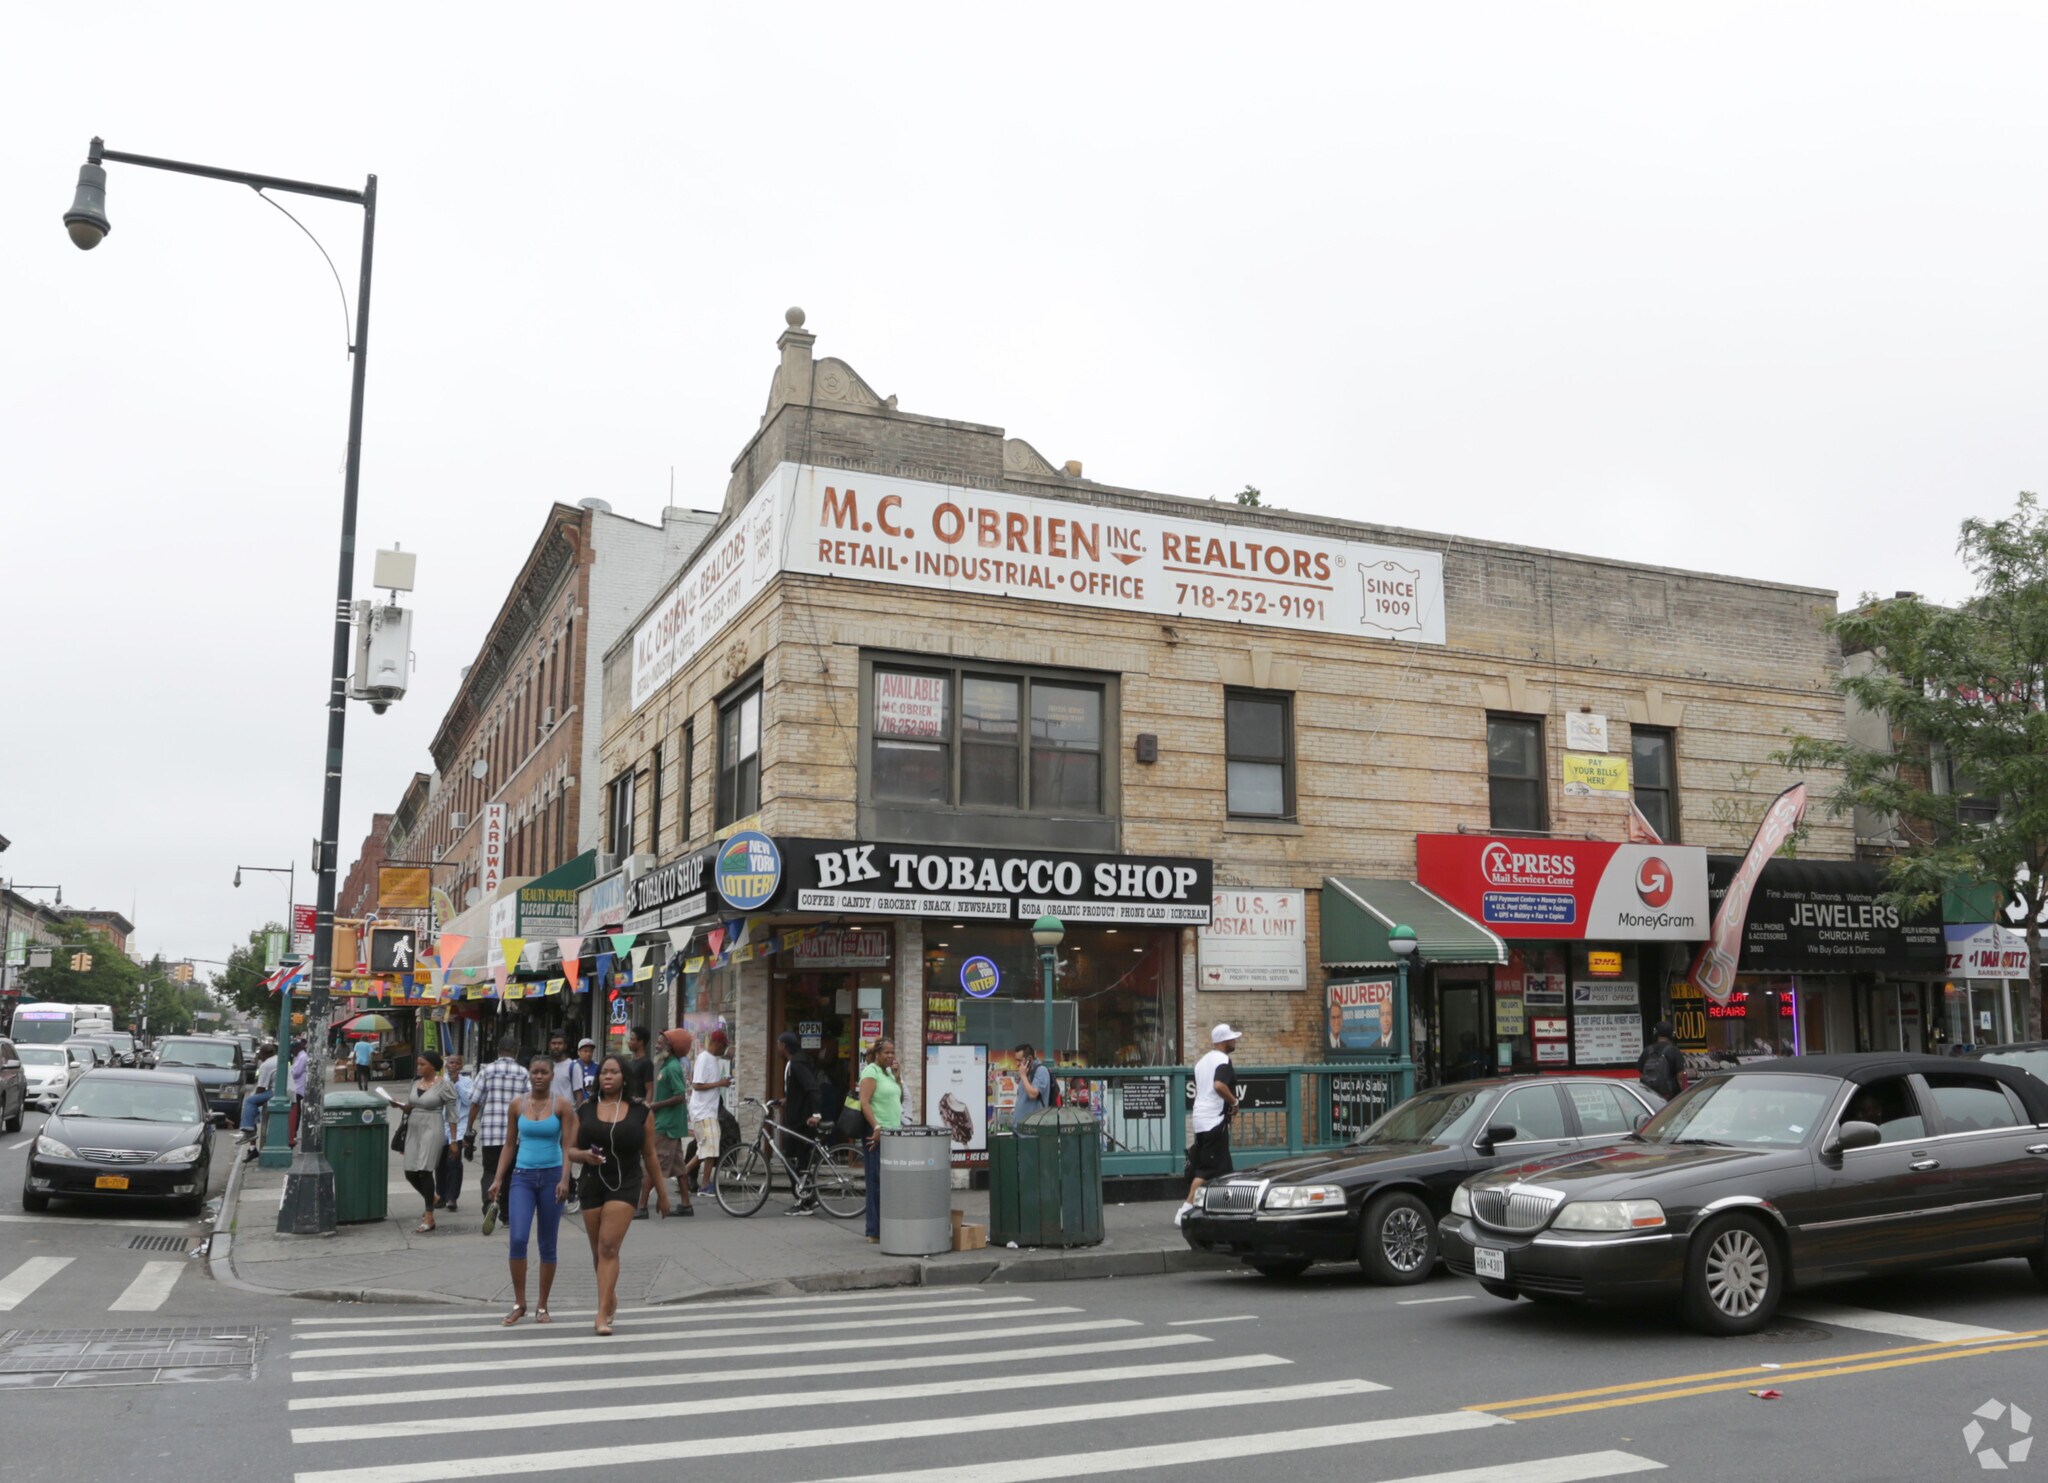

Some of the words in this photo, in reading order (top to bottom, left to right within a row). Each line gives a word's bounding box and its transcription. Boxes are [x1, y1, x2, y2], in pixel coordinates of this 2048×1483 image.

[820, 487, 914, 539] M.C.
[932, 502, 1100, 562] O'BRIEN
[1107, 526, 1146, 552] INC.
[819, 539, 899, 571] RETAIL
[915, 551, 1056, 589] INDUSTRIAL
[1070, 571, 1144, 599] OFFICE
[1367, 578, 1413, 597] SINCE
[1175, 583, 1325, 621] 718-252-9191
[1376, 599, 1410, 616] 1909
[882, 674, 940, 701] AVAILABLE
[1574, 767, 1594, 775] YOUR
[1597, 768, 1617, 776] BILLS
[749, 840, 770, 855] NEW
[750, 854, 775, 872] YORK
[815, 844, 880, 888] BK
[889, 854, 1082, 895] TOBACCO
[1094, 863, 1197, 898] SHOP
[1491, 852, 1575, 875] X-PRESS
[638, 867, 676, 910] TOBACCO
[677, 855, 703, 896] SHOP
[721, 874, 776, 898] LOTTERY
[1492, 873, 1510, 883] Mail
[1512, 874, 1545, 884] Services
[1547, 875, 1574, 885] Center
[522, 888, 545, 901] BEAUTY
[802, 894, 835, 906] COFFEE
[842, 896, 871, 908] CANDY
[878, 898, 917, 911] GROCERY
[923, 900, 951, 911] SNACK
[957, 902, 1007, 913] NEWSPAPER
[1767, 890, 1780, 898] Fine
[1782, 890, 1805, 901] Jewelry
[1811, 892, 1841, 901] Diamonds
[1846, 893, 1872, 902] Watches
[521, 903, 555, 916] DISCOUNT
[1022, 904, 1041, 914] SODA
[1047, 904, 1080, 916] ORGANIC
[1082, 906, 1115, 917] PRODUCT
[1120, 907, 1144, 918] PHONE
[1147, 908, 1166, 919] CARD
[1171, 908, 1207, 920] ICECREAM
[1236, 897, 1268, 915] U.S.
[1618, 912, 1694, 930] MoneyGram
[1790, 903, 1899, 928] JEWELERS
[1205, 917, 1257, 935] POSTAL
[1264, 919, 1297, 936] UNIT
[1819, 930, 1852, 940] CHURCH
[1854, 931, 1870, 940] AVE
[857, 933, 881, 955] ATM
[1808, 945, 1818, 953] We
[1820, 945, 1831, 955] Buy
[1833, 945, 1847, 954] Gold
[1855, 946, 1885, 954] Diamonds
[1981, 951, 1999, 967] DAH
[1527, 976, 1564, 992] FedEx
[1687, 985, 1702, 997] BU
[1331, 983, 1392, 1005] INJURED?
[1710, 1006, 1746, 1016] REPAIRS
[800, 1024, 820, 1034] OPEN
[1674, 1011, 1706, 1039] GOLD
[970, 1152, 980, 1160] ICE
